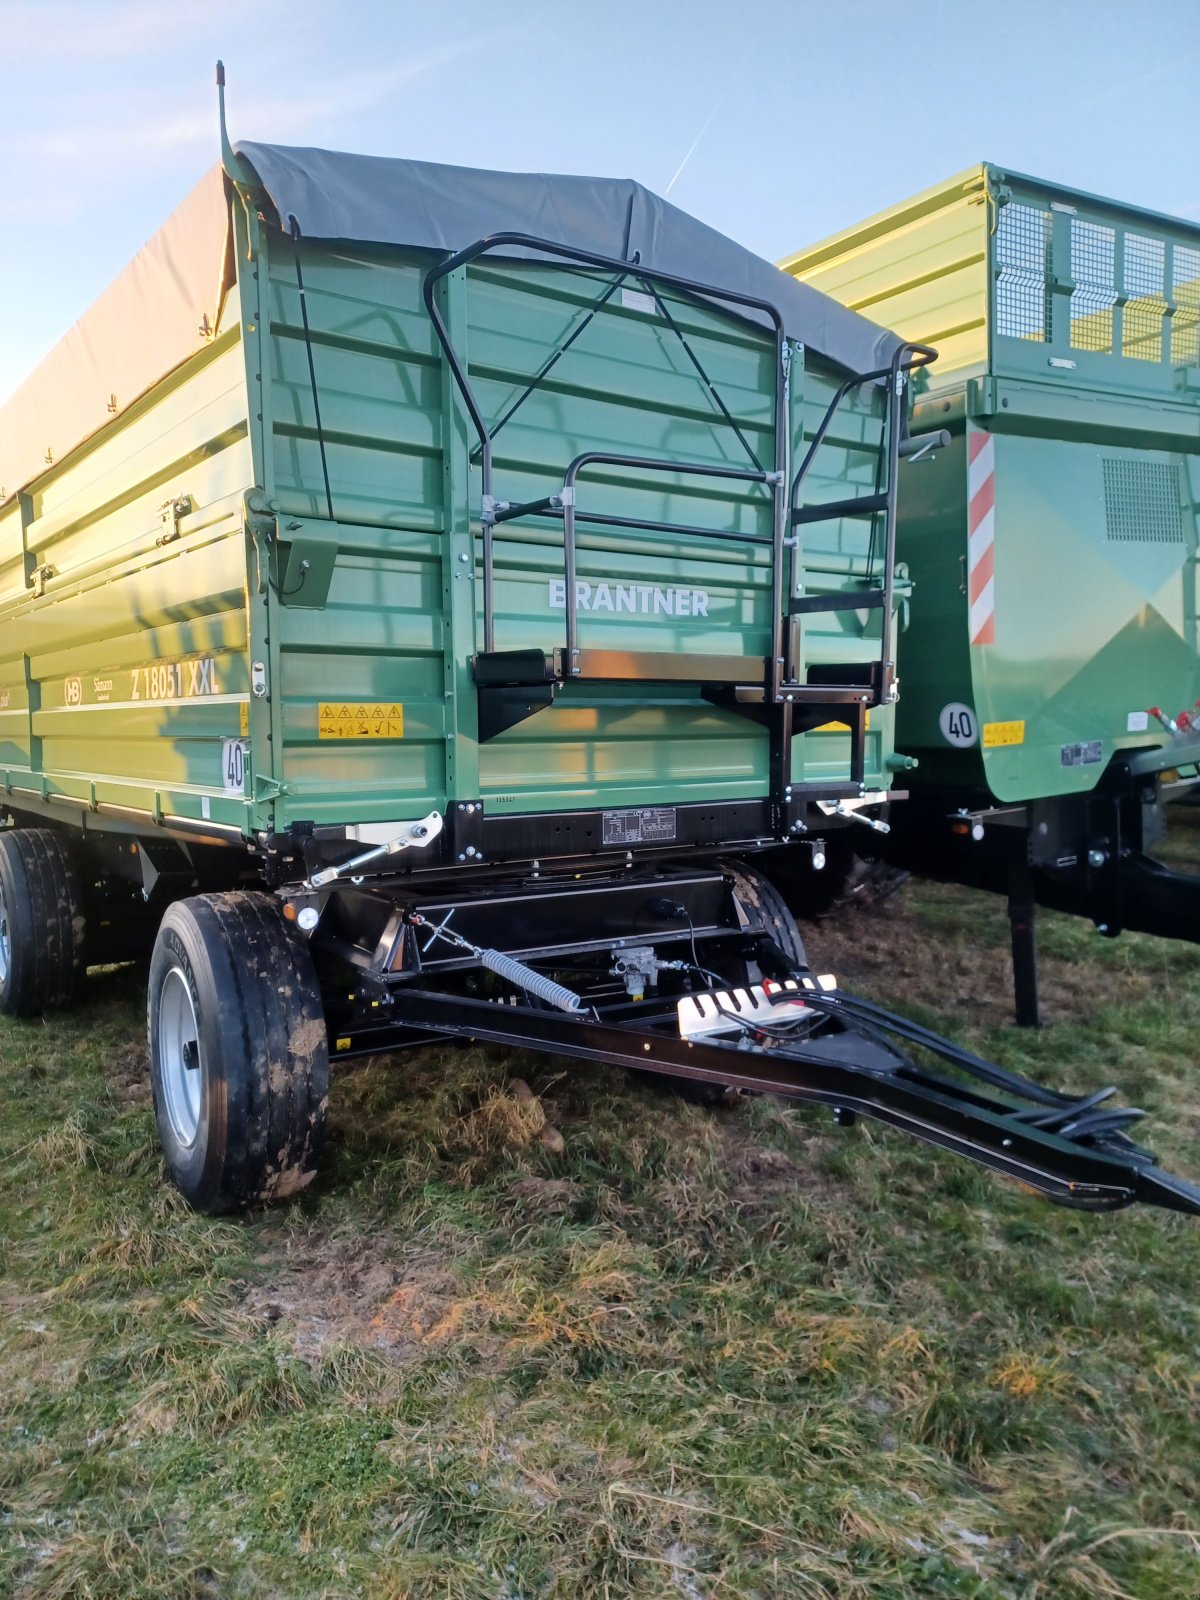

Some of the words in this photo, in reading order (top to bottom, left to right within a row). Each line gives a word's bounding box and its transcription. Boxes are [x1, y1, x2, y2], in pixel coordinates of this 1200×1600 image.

[548, 578, 709, 617] BRANTNER
[131, 669, 140, 700] Z
[143, 663, 182, 700] 18051
[187, 658, 219, 696] XXL
[949, 711, 972, 738] 40
[227, 743, 243, 787] 40
